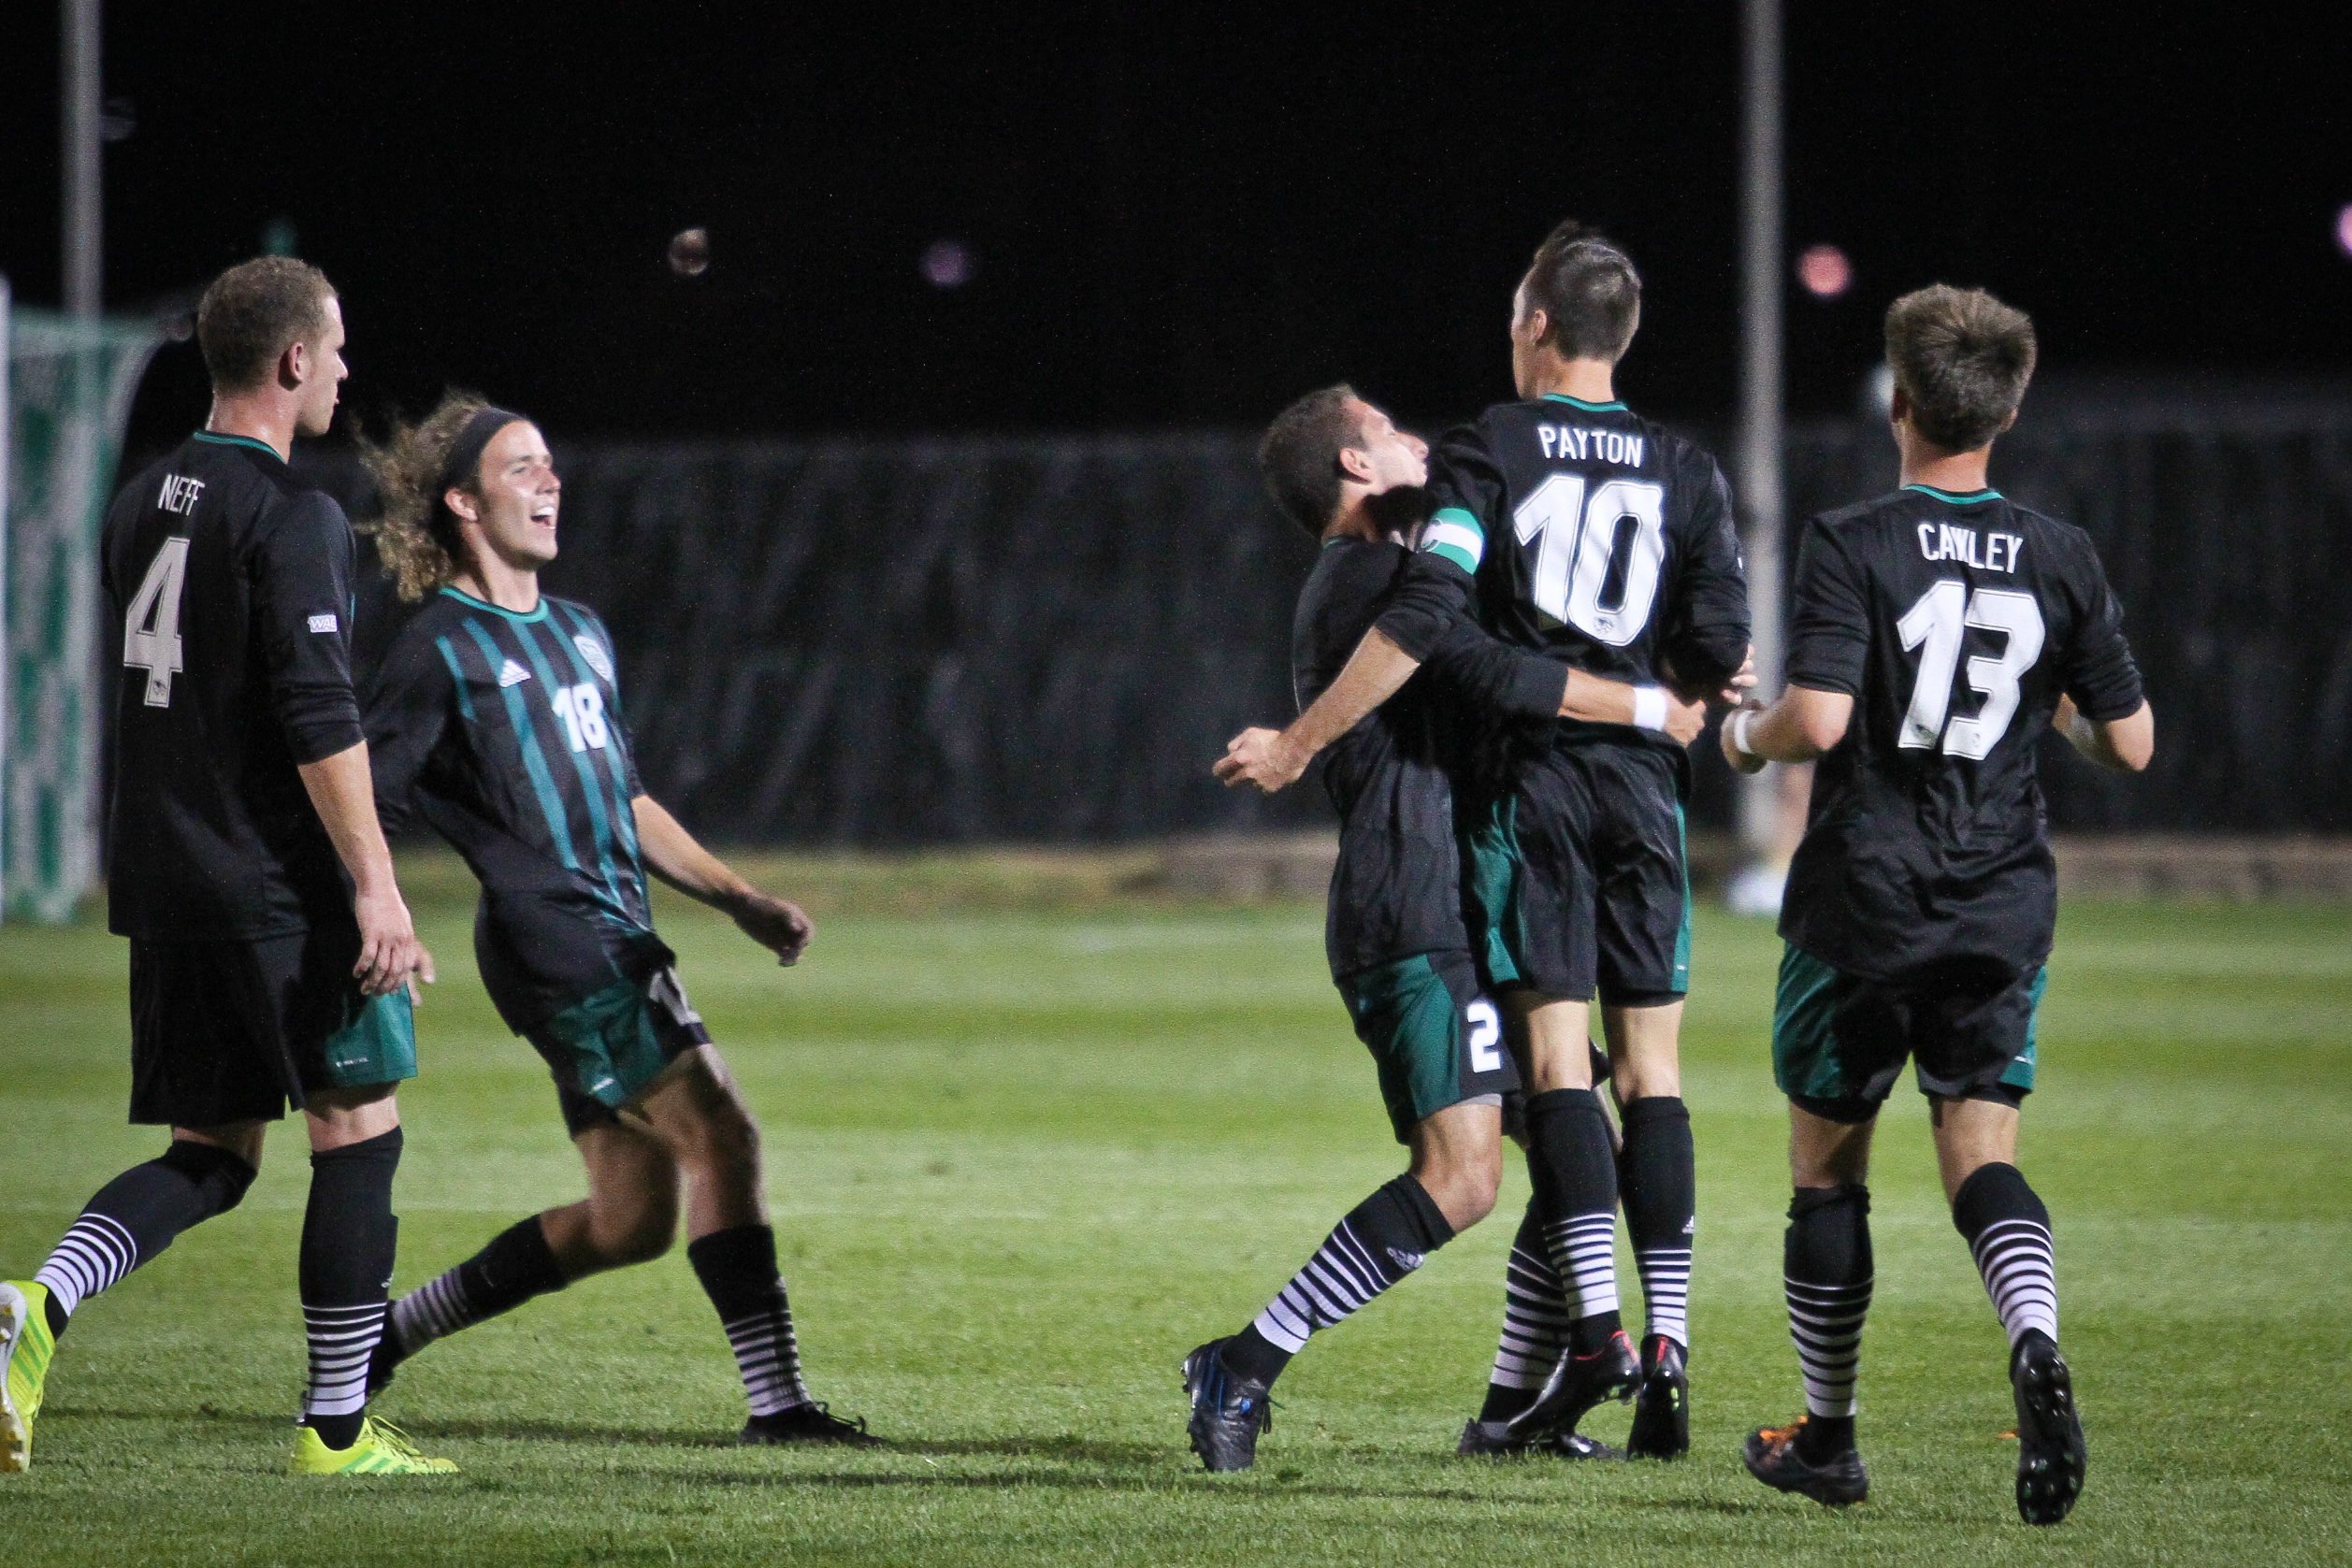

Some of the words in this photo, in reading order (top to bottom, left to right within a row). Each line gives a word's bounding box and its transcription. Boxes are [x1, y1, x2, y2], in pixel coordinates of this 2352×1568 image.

[1537, 426, 1643, 468] PAYTON
[157, 473, 206, 516] NEFF
[1513, 474, 1665, 647] 10
[1917, 523, 2024, 574] CAWLEY
[123, 536, 190, 709] 4
[1896, 580, 2046, 761] 13
[551, 682, 608, 754] 18
[1466, 998, 1502, 1073] 2
